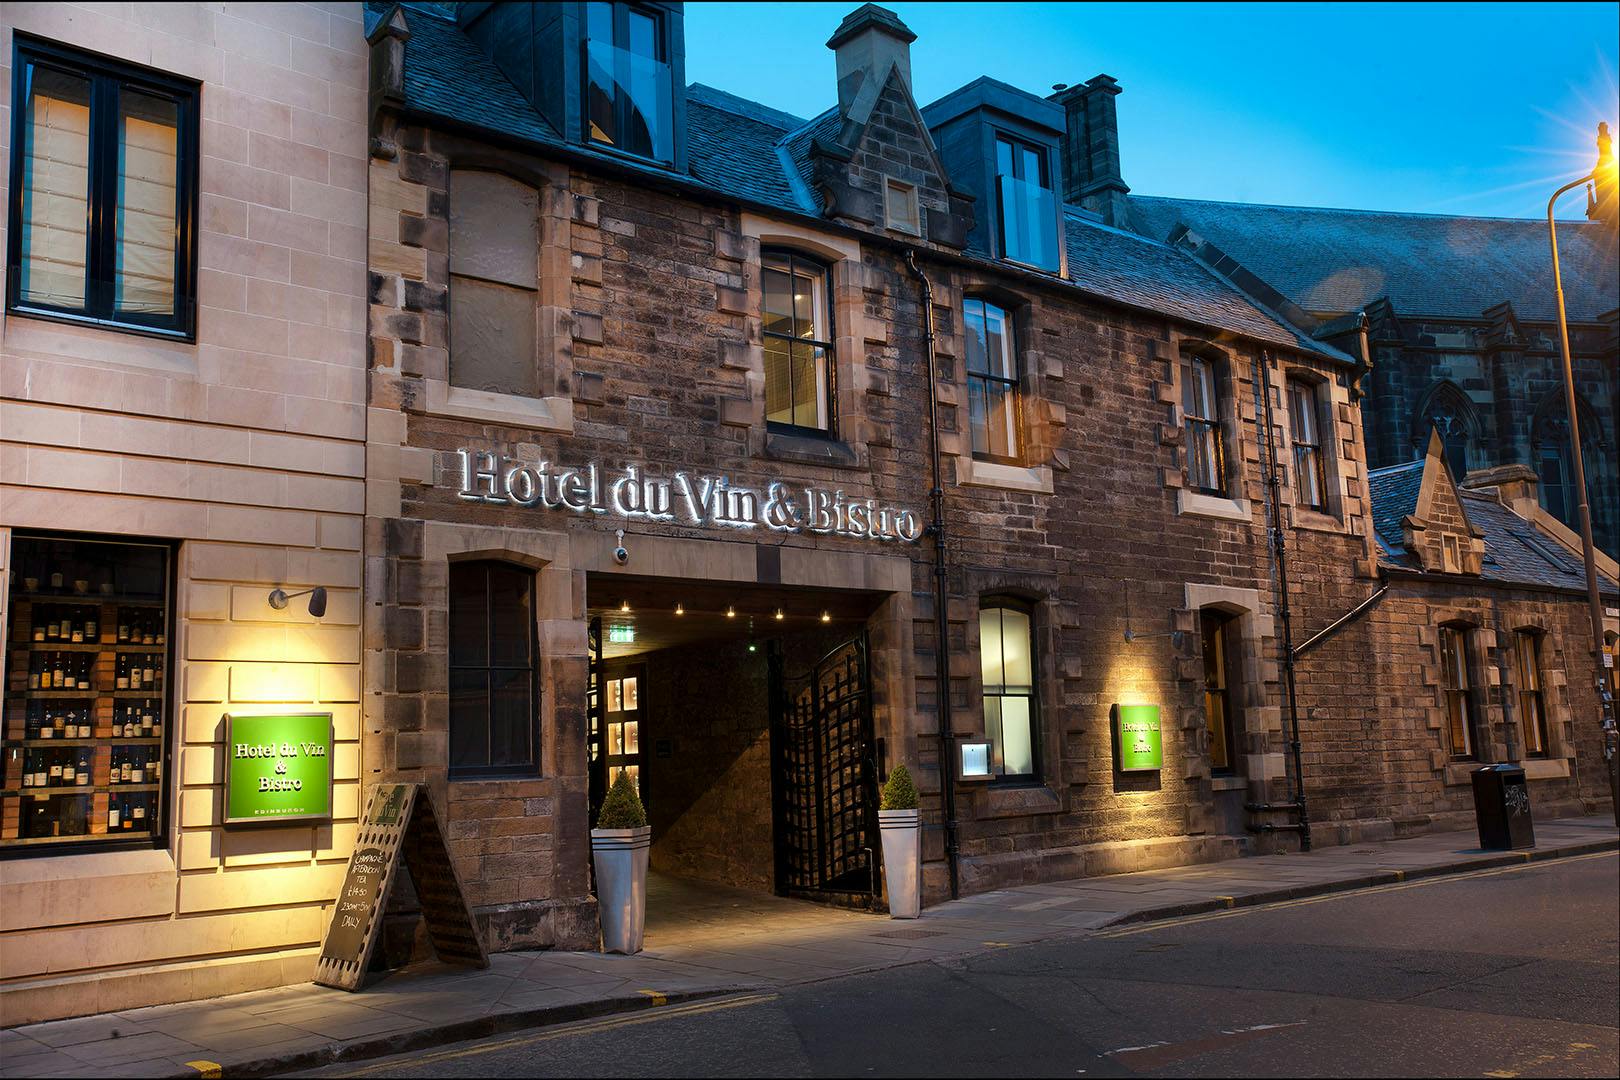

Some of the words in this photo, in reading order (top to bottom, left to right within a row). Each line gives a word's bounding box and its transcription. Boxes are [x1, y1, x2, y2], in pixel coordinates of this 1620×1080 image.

[457, 448, 608, 512] Hotel
[614, 464, 676, 518] du
[675, 471, 763, 526] Vin
[763, 480, 803, 532] &
[804, 486, 923, 541] Bistro
[235, 742, 276, 758] Hotel
[280, 742, 297, 757] du
[301, 741, 325, 756] Vin
[275, 761, 287, 774] &
[259, 776, 302, 792] Bistro
[341, 914, 361, 928] DAILY
